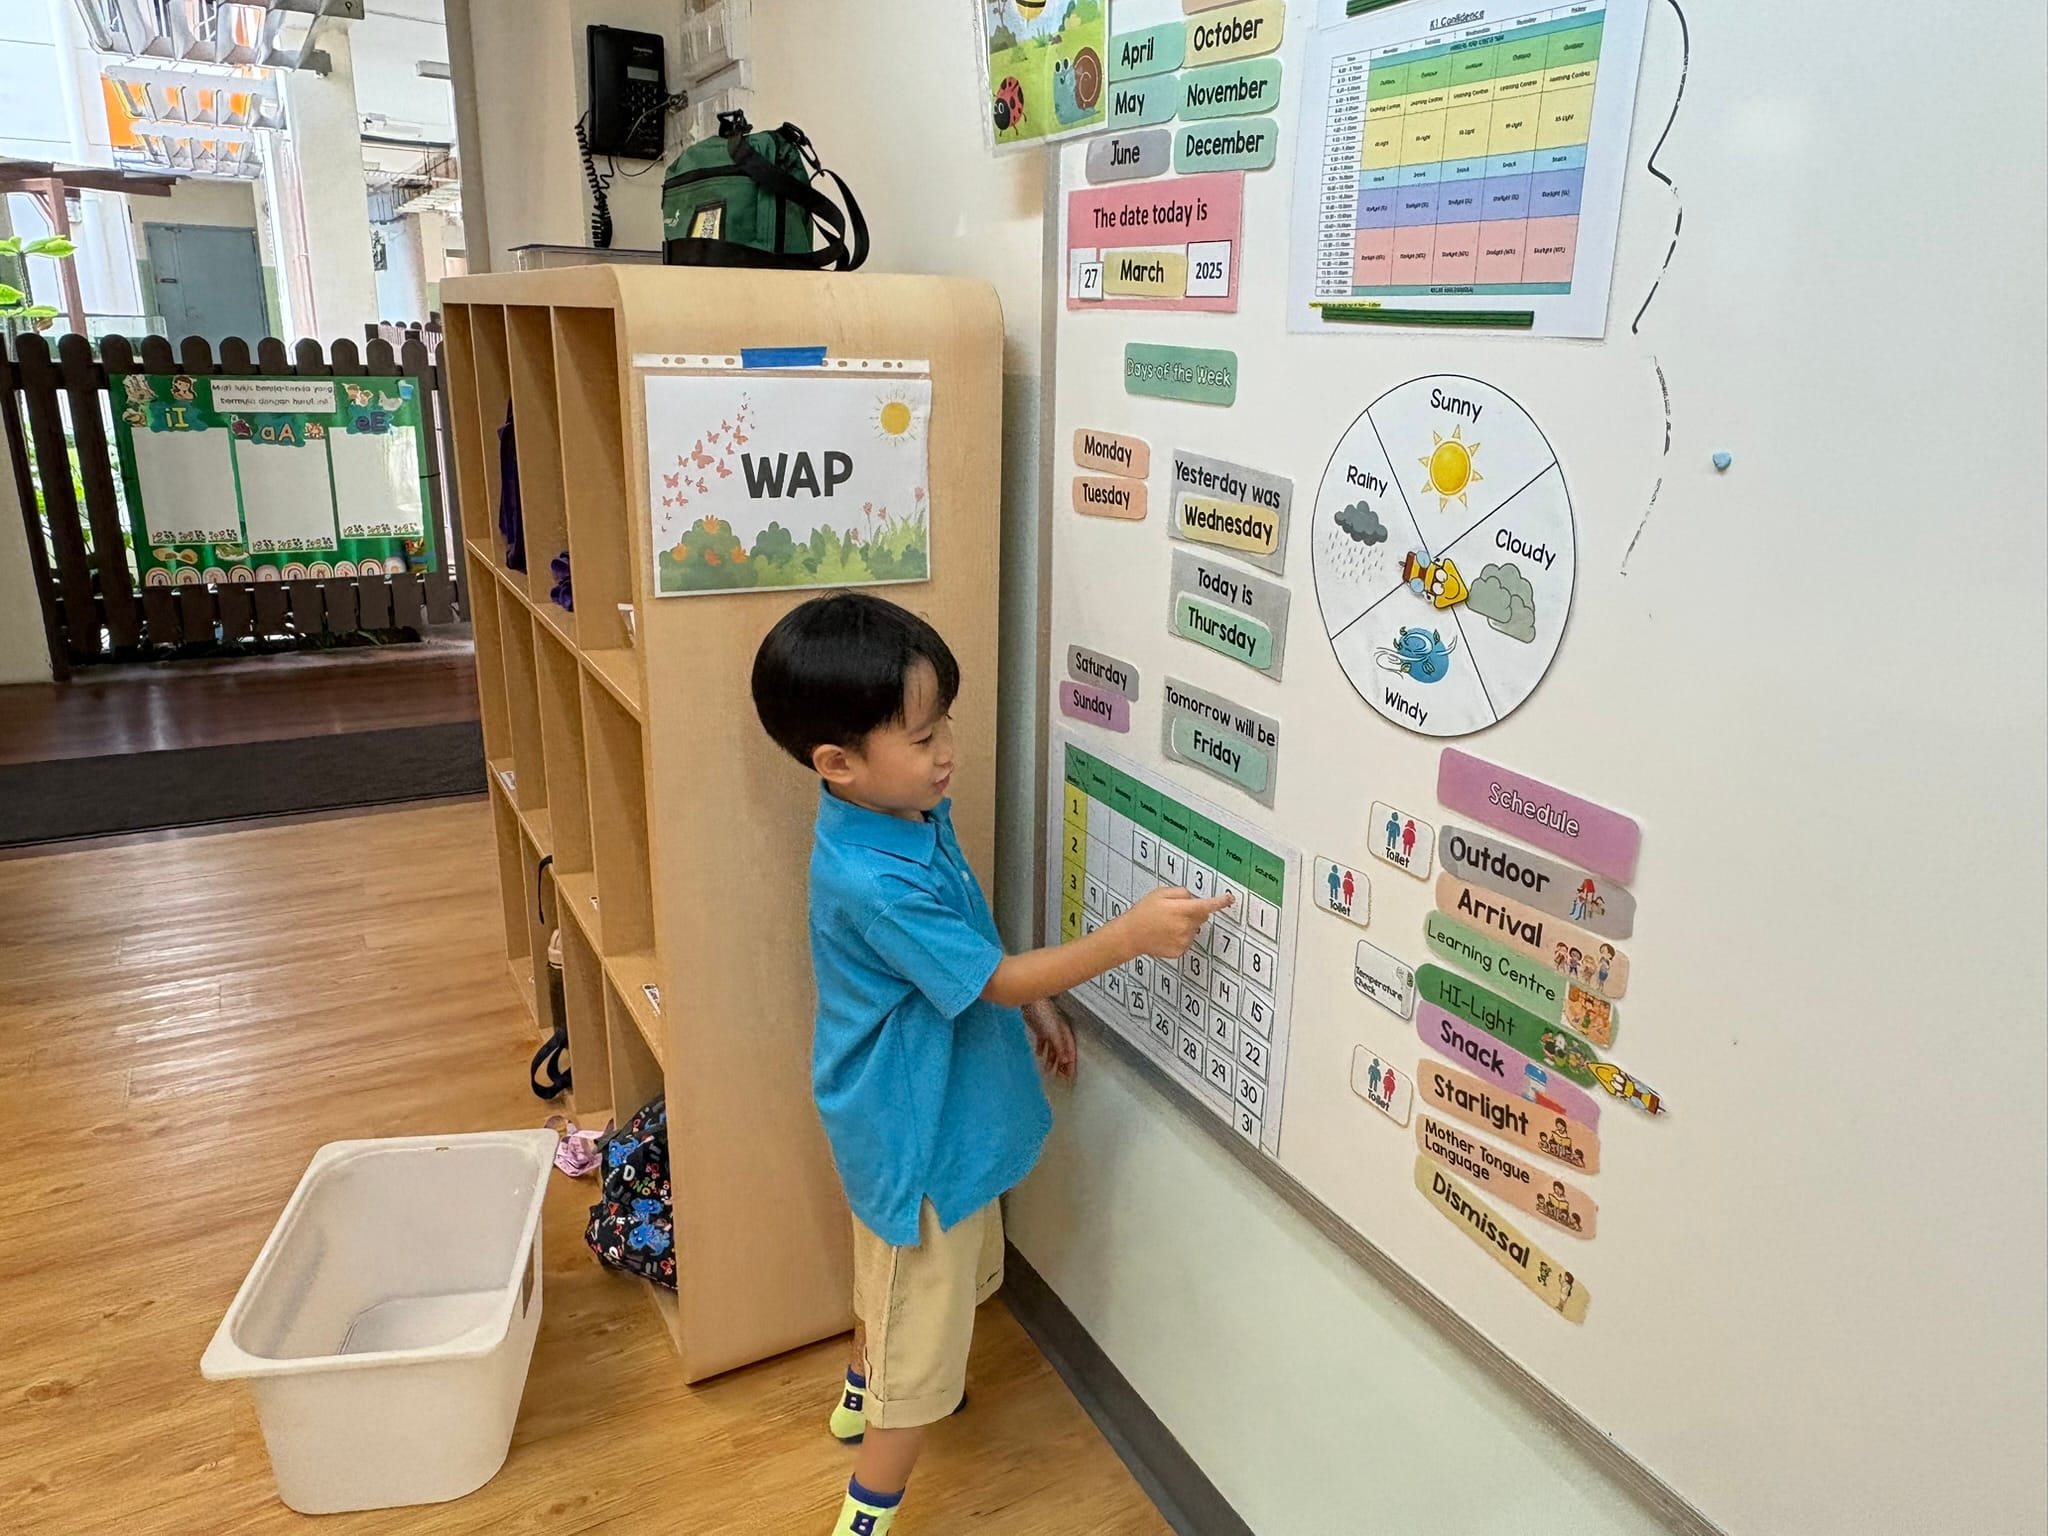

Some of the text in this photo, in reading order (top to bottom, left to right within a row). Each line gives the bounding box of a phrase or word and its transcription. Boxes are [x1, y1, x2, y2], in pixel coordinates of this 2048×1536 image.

[1193, 16, 1264, 51] October
[1440, 9, 1484, 28] Confidence
[1121, 36, 1154, 72] April
[1114, 92, 1144, 116] May
[1186, 77, 1268, 106] November
[1110, 140, 1140, 166] June
[1186, 130, 1264, 157] December
[1093, 198, 1208, 229] The date today is
[1084, 260, 1223, 289] 27 March 2025
[1126, 358, 1232, 388] Days of the Week
[1430, 388, 1482, 424] Sunny
[1084, 435, 1132, 468] Monday
[740, 450, 854, 499] WAP
[1175, 460, 1280, 509] Yesterday was
[1346, 465, 1389, 498] Rainy
[1082, 483, 1130, 510] Tuesday
[1184, 504, 1273, 546] Wednesday
[1495, 528, 1557, 571] Cloudy
[1197, 567, 1253, 606] Today is
[1188, 606, 1257, 657] Thursday
[1076, 652, 1128, 692] Saturday
[1073, 690, 1112, 721] Sunday
[1166, 686, 1275, 747] Tomorrow will be
[1384, 686, 1428, 727] Windy
[1193, 729, 1241, 773] Friday
[1488, 782, 1580, 838] Schedule
[1073, 800, 1264, 928] 1 5 4 3 1
[1385, 846, 1410, 869] Toilet
[1449, 836, 1551, 893] Outdoor
[1071, 836, 1261, 973] 2 7 8
[1328, 898, 1352, 918] Toilet
[1457, 888, 1544, 948] Arrival
[1070, 874, 1077, 890] 3
[1090, 887, 1096, 904] 9
[1190, 955, 1200, 976] 13
[1219, 980, 1230, 1002] 14
[1251, 1000, 1264, 1023] 15
[1426, 916, 1556, 1002] Learning Centre
[1069, 912, 1076, 927] 4
[1135, 957, 1143, 976] 18
[1161, 974, 1170, 995] 19
[1185, 994, 1200, 1017] 20
[1216, 1018, 1226, 1039] 21
[1245, 1041, 1260, 1067] 22
[1354, 976, 1376, 996] Check
[1355, 965, 1403, 1002] Temperature
[1439, 980, 1516, 1039] HI-Light
[1108, 973, 1258, 1104] 24 25 26 28 29 30
[1440, 1018, 1506, 1079] Snack
[1366, 1088, 1390, 1112] Toilet
[1434, 1073, 1529, 1137] Starlight
[1241, 1113, 1253, 1136] 31
[1424, 1118, 1531, 1185] Mother Tongue
[1424, 1134, 1491, 1182] Language
[1432, 1170, 1531, 1270] Dismissal
